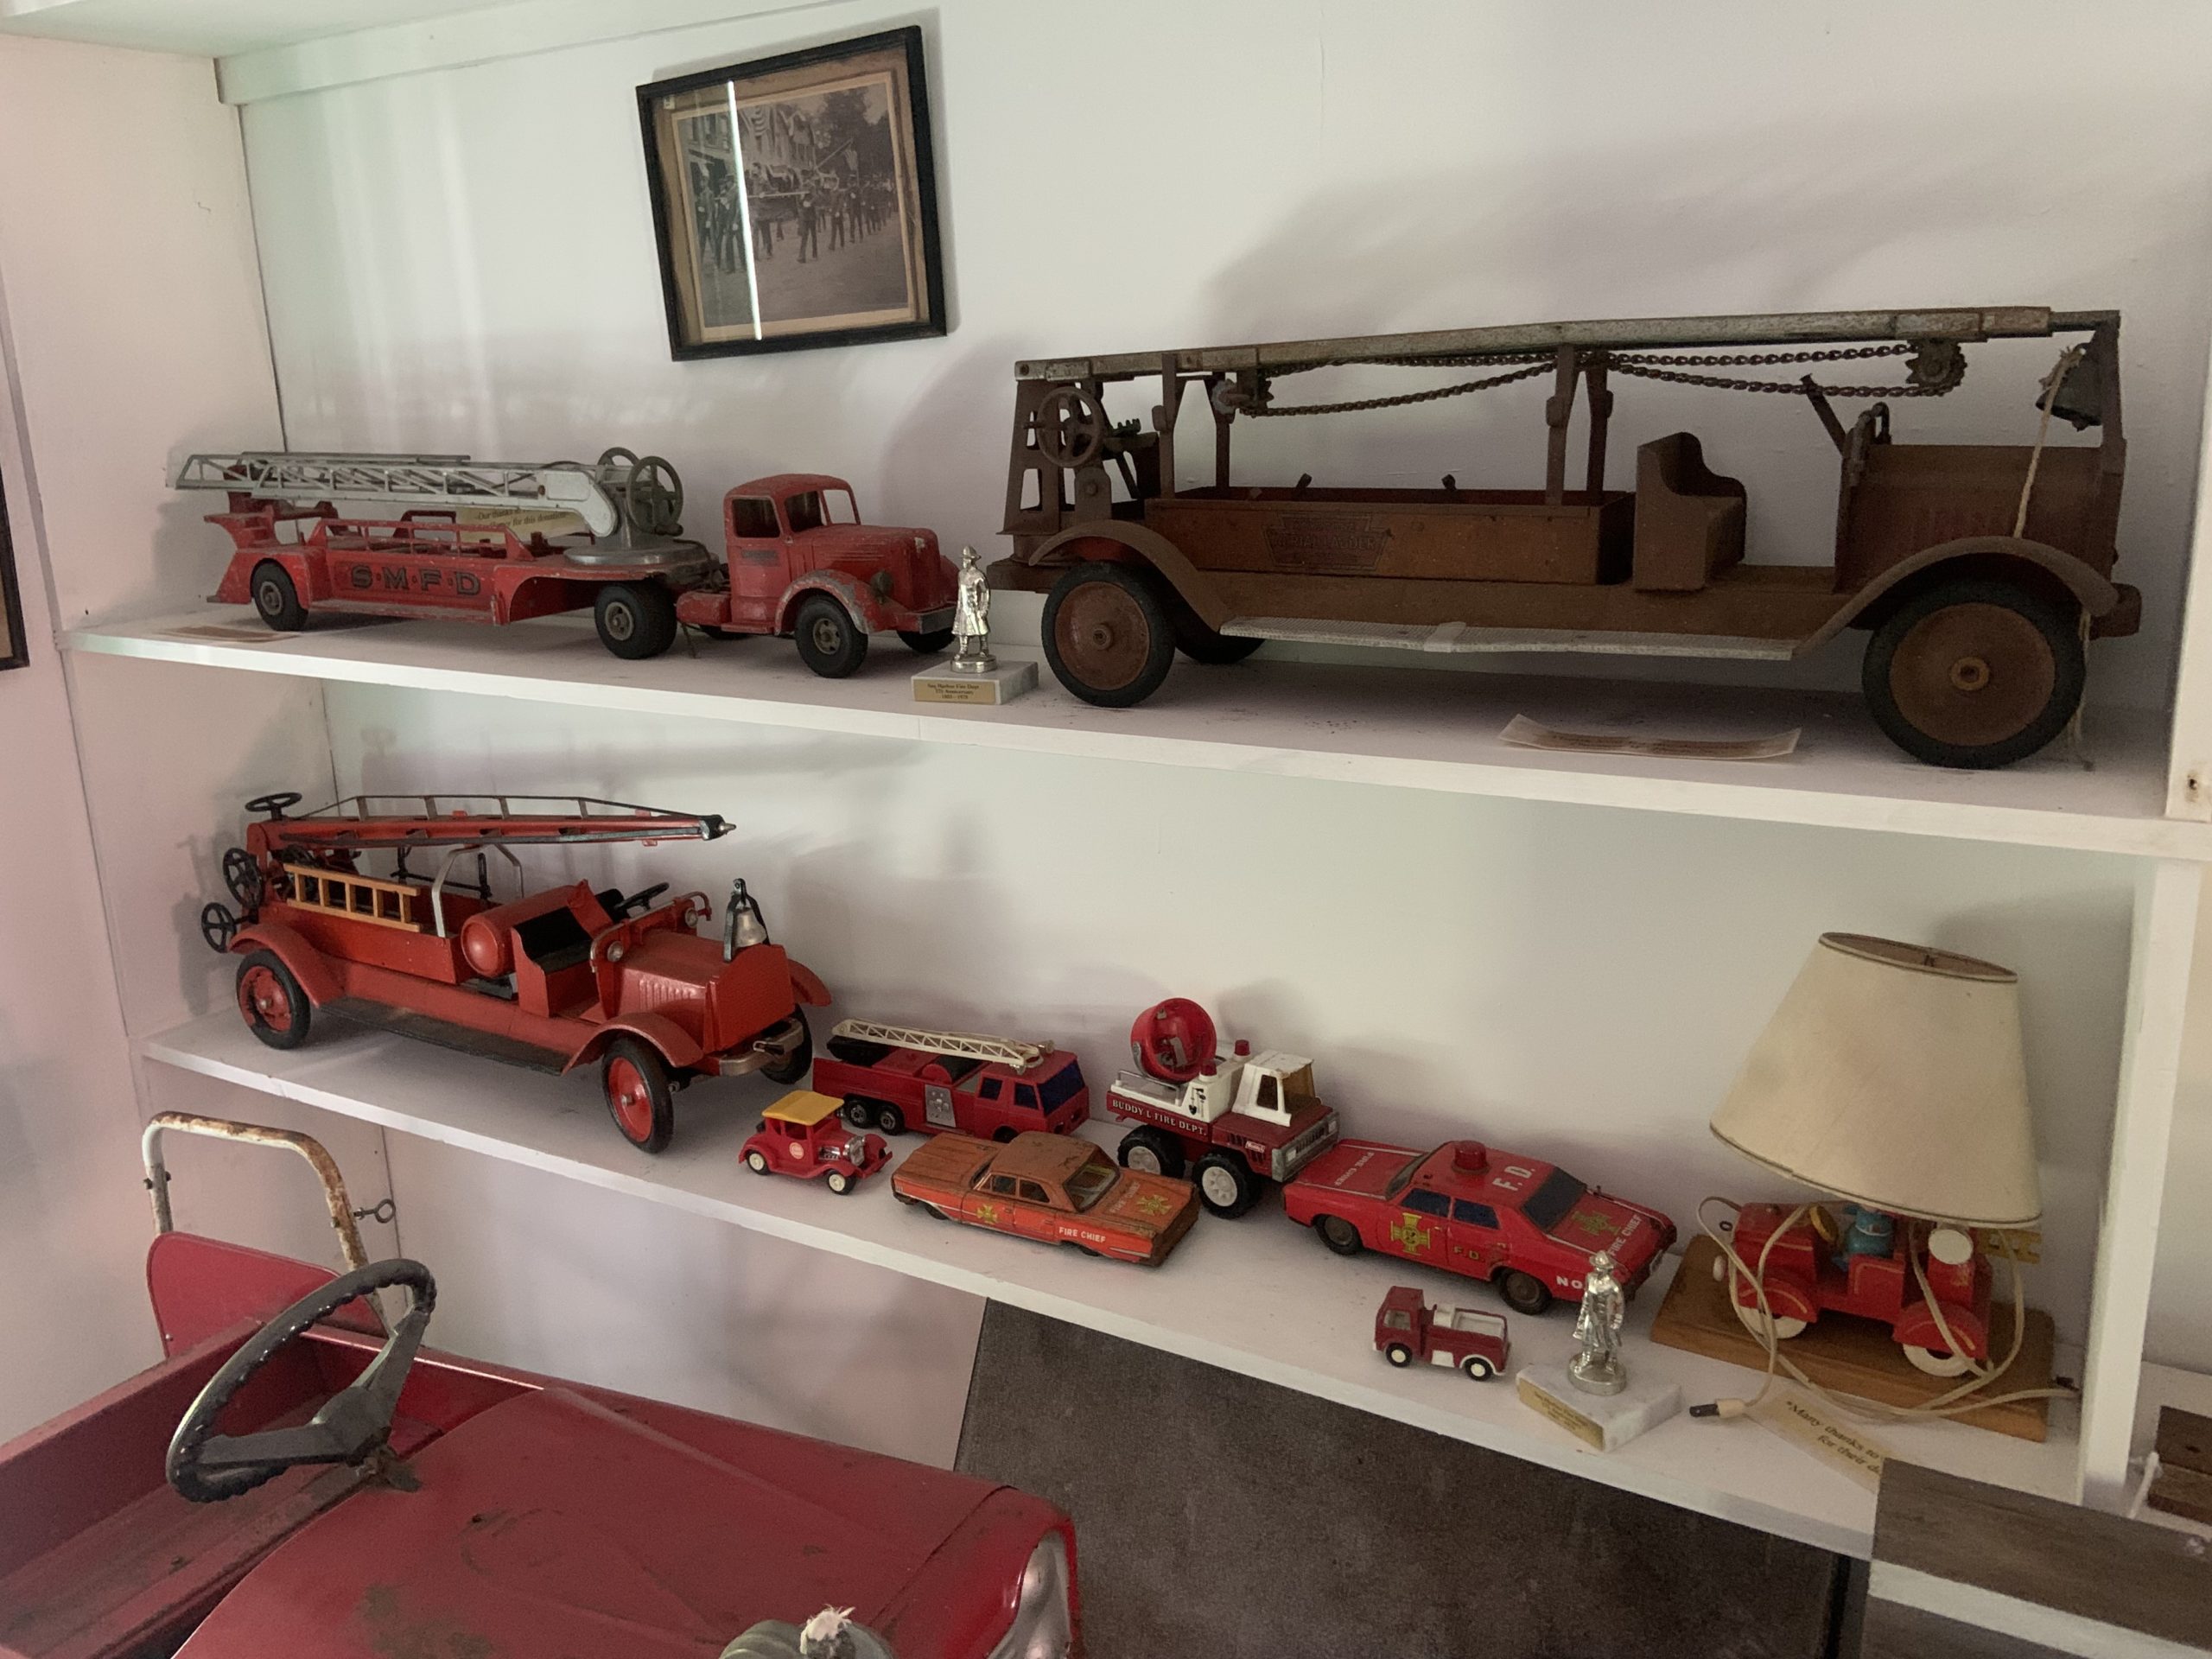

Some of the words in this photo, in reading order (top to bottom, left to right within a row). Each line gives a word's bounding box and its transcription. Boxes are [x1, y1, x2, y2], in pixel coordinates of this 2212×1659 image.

[1112, 1099, 1144, 1116] BUDDY
[1154, 1113, 1176, 1126] FIRE
[1179, 1121, 1207, 1136] DEPT.
[1058, 1226, 1079, 1237] FIRE
[1080, 1230, 1107, 1243] CHIEF
[1608, 1236, 1626, 1257] FIRE
[1621, 1213, 1643, 1236] CHIEF
[1817, 1434, 1837, 1447] for
[1837, 1446, 1867, 1465] their
[1825, 1426, 1864, 1451] thanks
[1866, 1449, 1880, 1459] to
